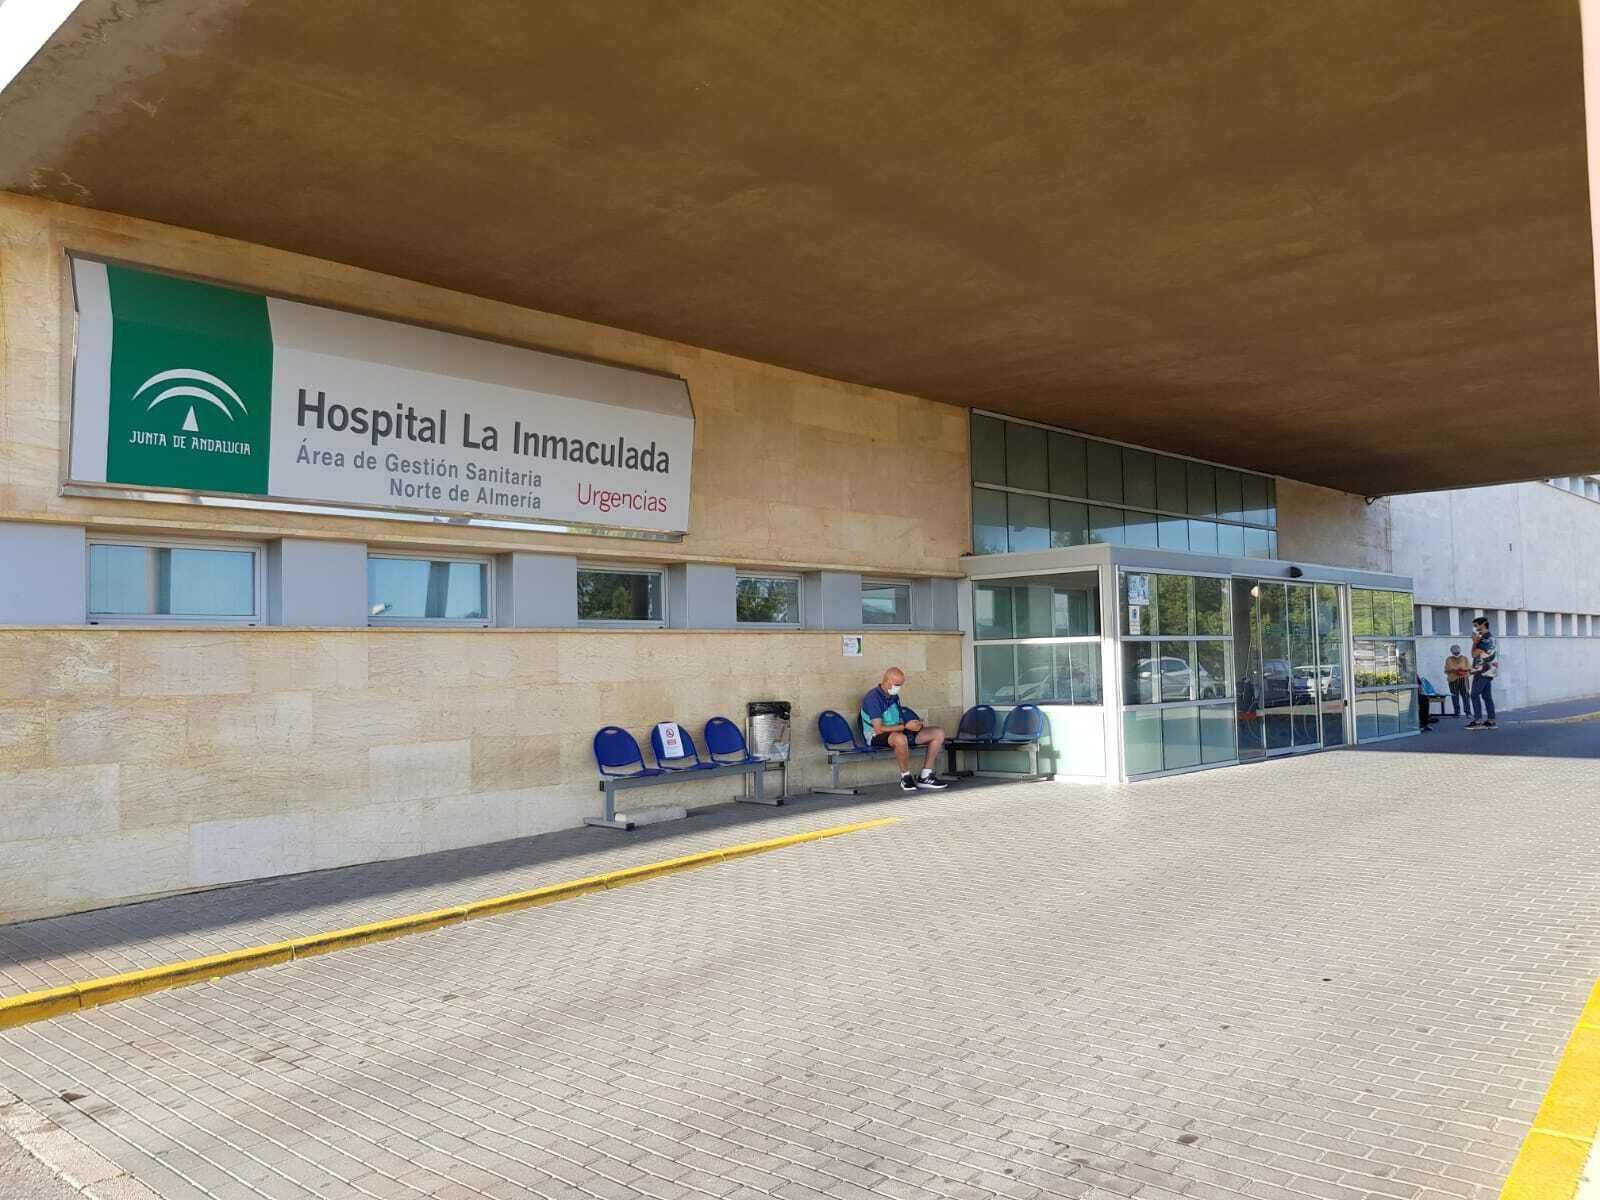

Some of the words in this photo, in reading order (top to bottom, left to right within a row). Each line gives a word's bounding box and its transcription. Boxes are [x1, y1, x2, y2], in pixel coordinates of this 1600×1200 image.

[129, 430, 167, 446] JUNTA
[172, 435, 187, 449] DE
[191, 437, 251, 456] ANDALUCIA
[297, 388, 447, 446] Hospital
[463, 413, 498, 452] La
[513, 421, 670, 474] Inmaculada
[296, 438, 345, 468] Área
[353, 451, 377, 470] de
[385, 453, 458, 479] Gestión
[466, 462, 542, 488] Sanitaria
[389, 478, 442, 500] Norte
[448, 484, 470, 502] de
[476, 486, 541, 510] Almería
[577, 480, 667, 513] Urgencias
